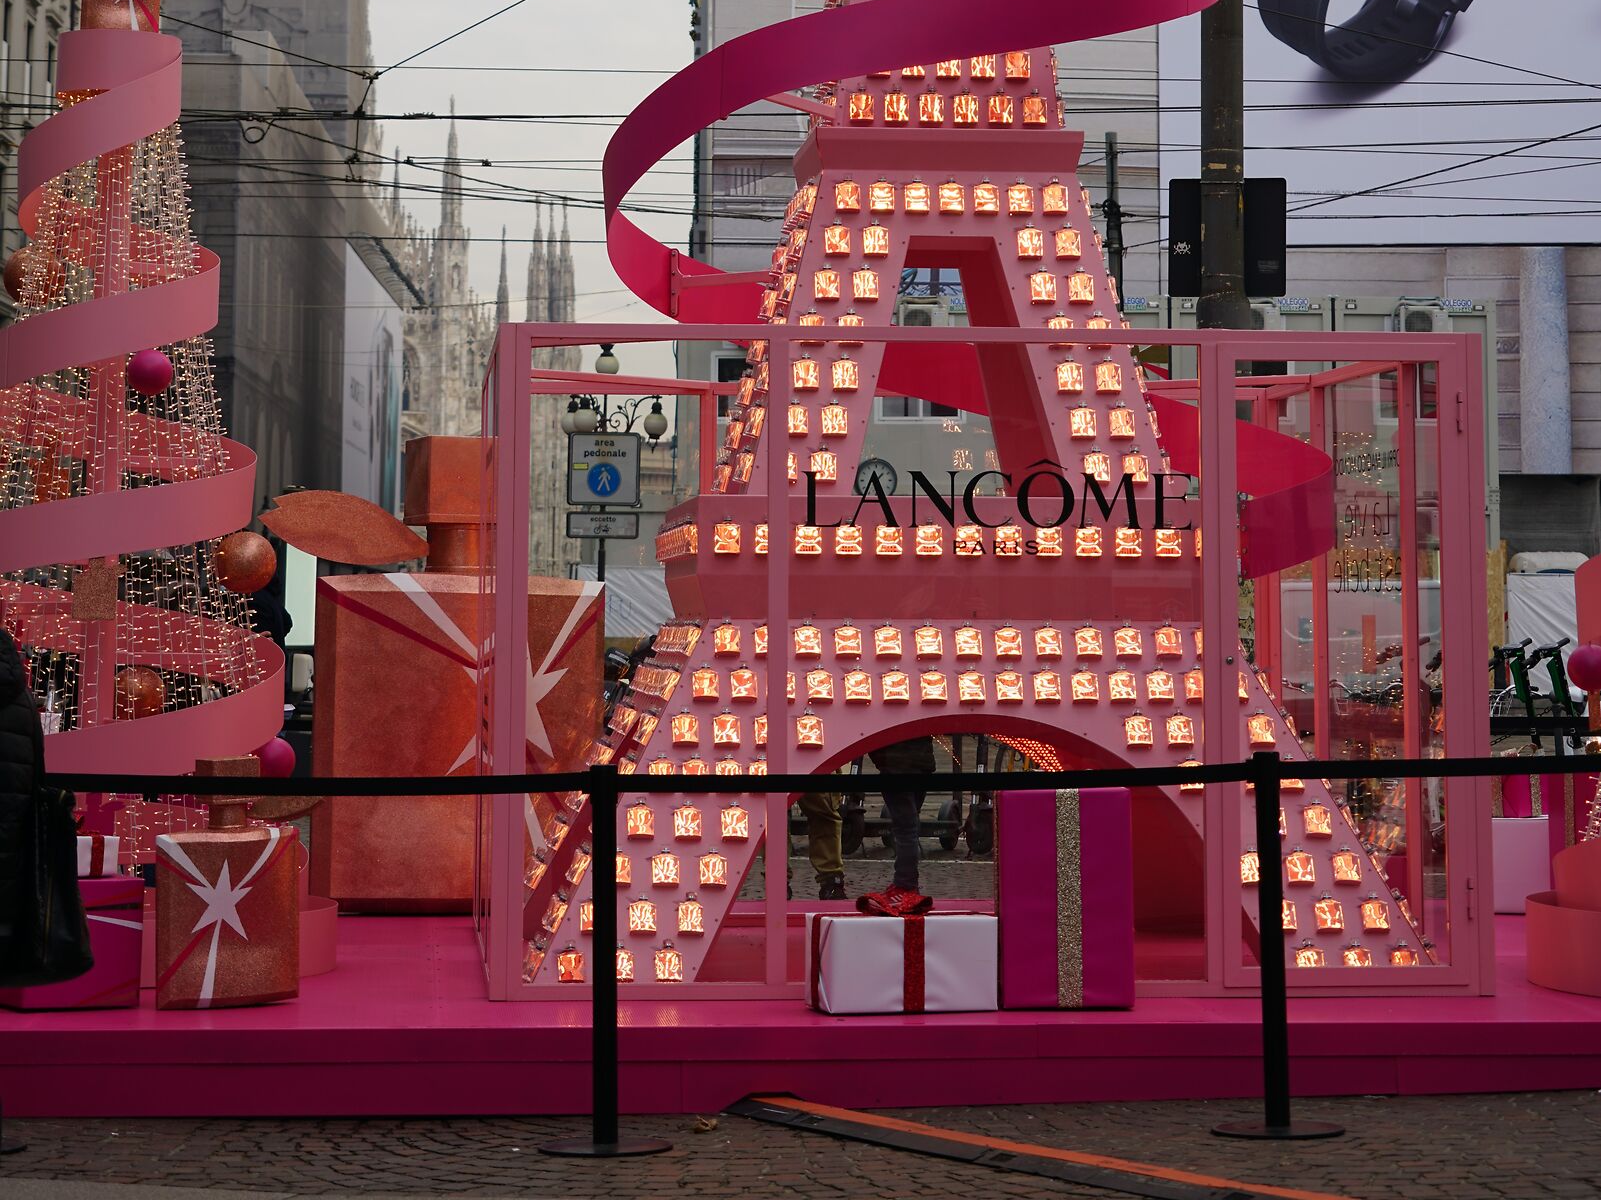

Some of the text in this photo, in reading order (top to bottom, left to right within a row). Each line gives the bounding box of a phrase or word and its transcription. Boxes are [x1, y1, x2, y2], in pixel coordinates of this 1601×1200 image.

[595, 439, 615, 447] area
[584, 448, 627, 458] pedonale
[800, 459, 1192, 530] LANCÔME
[953, 540, 1040, 555] PARIS
